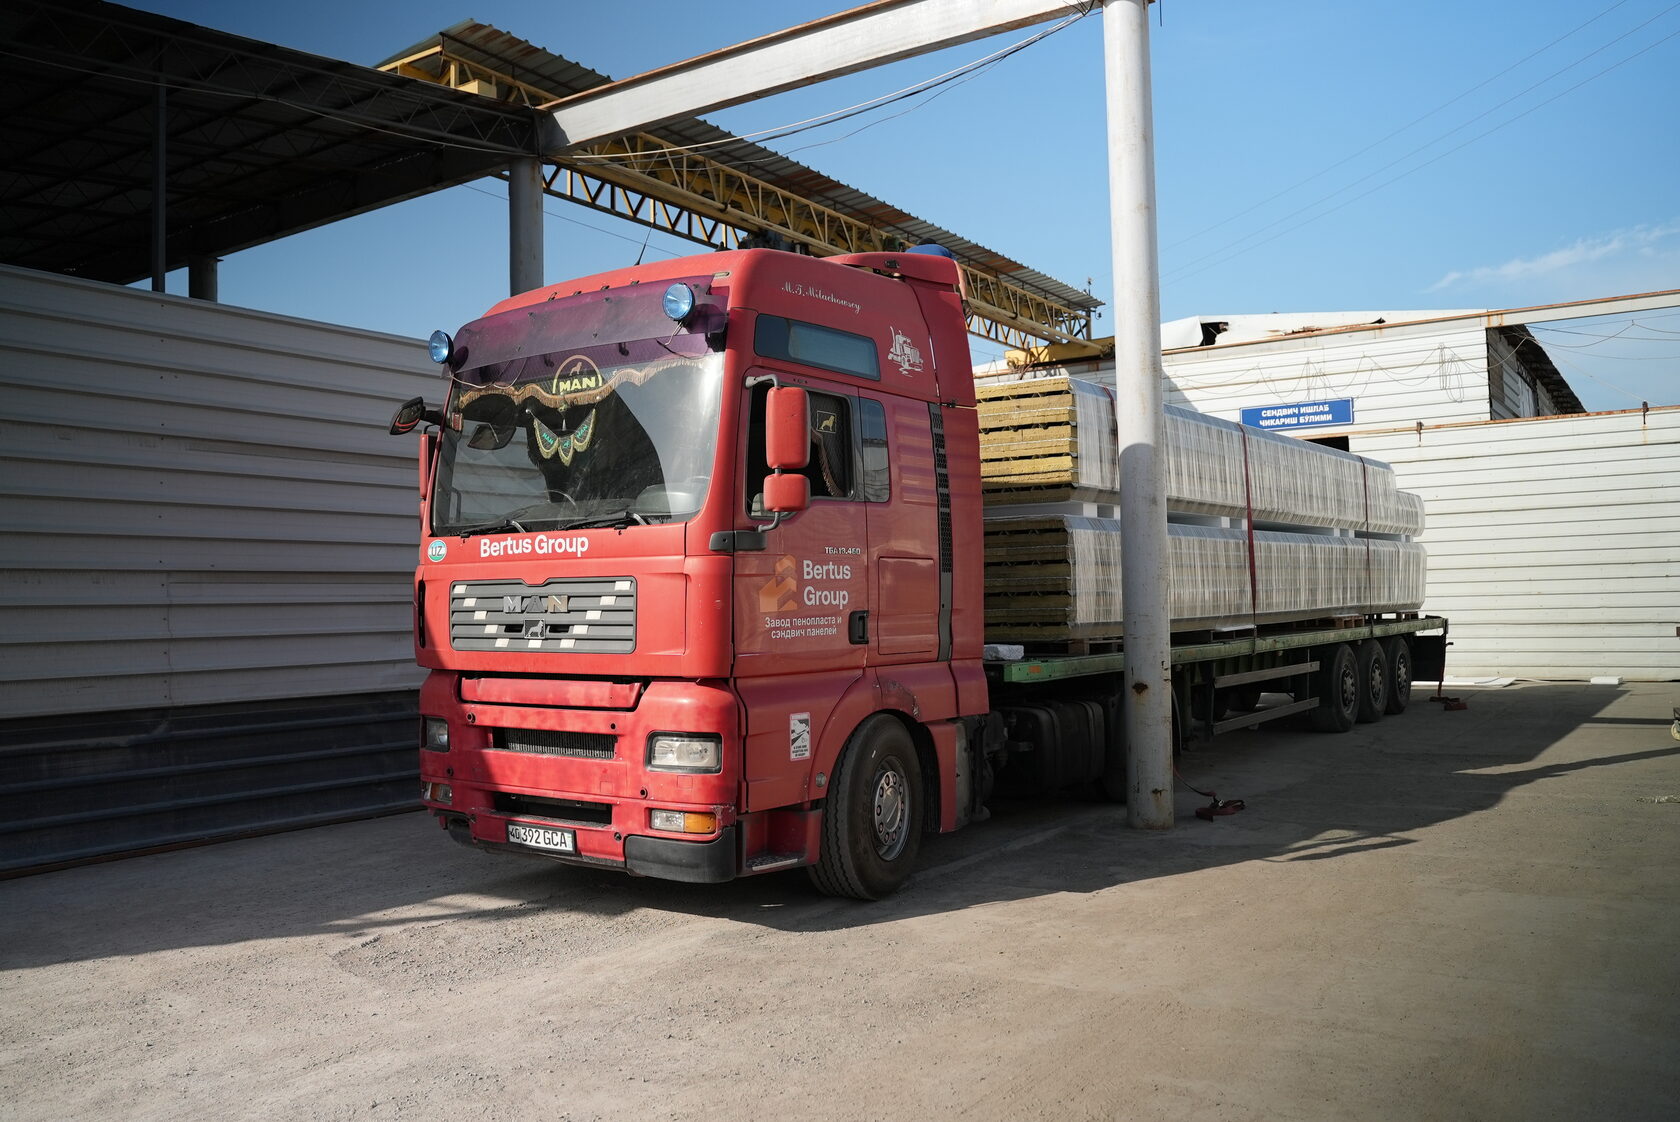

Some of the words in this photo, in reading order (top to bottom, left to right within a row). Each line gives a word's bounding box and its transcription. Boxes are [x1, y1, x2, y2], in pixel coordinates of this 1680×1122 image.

[559, 377, 595, 392] MAN
[1262, 408, 1298, 417] СЕНДВИЧ
[1300, 405, 1329, 413] ИШЛАБ
[431, 545, 443, 557] UZ
[480, 538, 532, 558] Bertus
[534, 534, 589, 557] Group
[803, 559, 851, 580] Bertus
[502, 594, 569, 614] MAN
[803, 586, 849, 609] Group
[764, 616, 791, 628] Завод
[792, 616, 835, 626] пенопласта
[771, 628, 805, 639] сэндвич
[806, 626, 837, 636] панелей
[521, 827, 541, 844] 392
[543, 830, 567, 848] GCA
